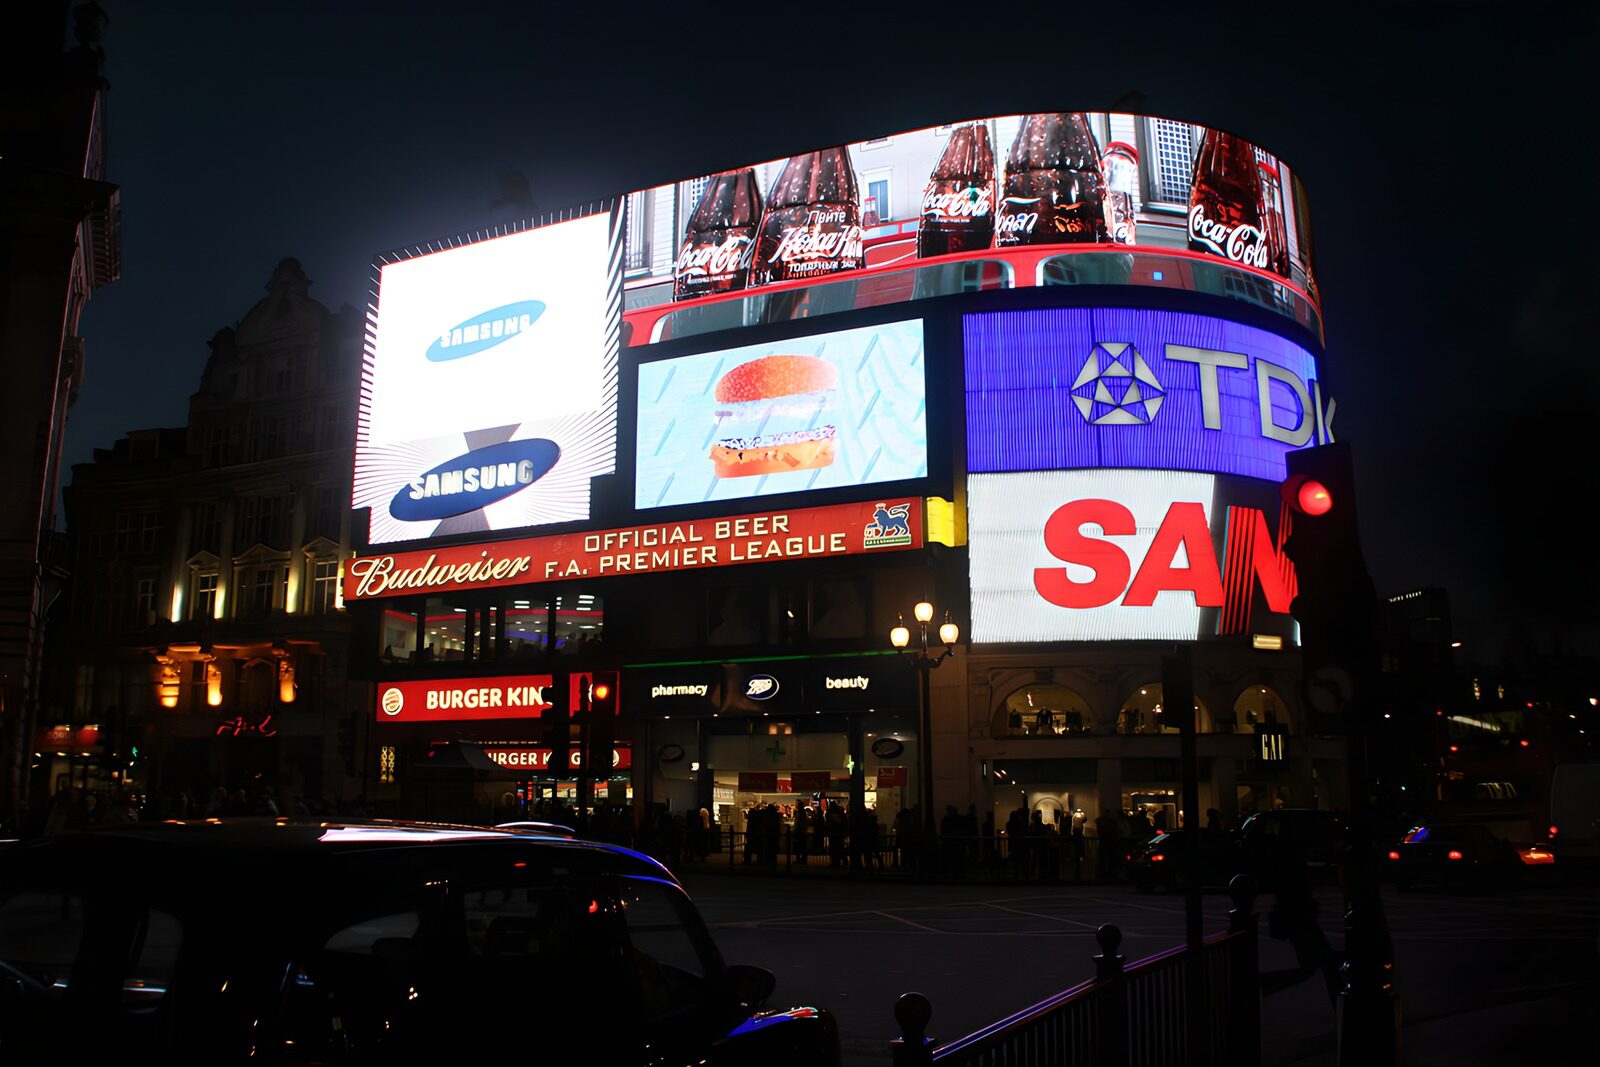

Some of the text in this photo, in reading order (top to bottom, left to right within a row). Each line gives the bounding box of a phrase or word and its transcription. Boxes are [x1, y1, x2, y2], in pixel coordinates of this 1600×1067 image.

[1188, 204, 1268, 268] Coca-Cola
[1164, 342, 1337, 447] TDK
[409, 459, 534, 500] SAMSUNG
[584, 515, 789, 552] OFFICIAL BEER
[351, 550, 531, 597] Budweiser
[545, 533, 846, 579] F.A. PREMIER LEAGUE
[426, 688, 503, 710] BURGER
[652, 684, 708, 698] pharmacy
[826, 675, 869, 690] beauty
[487, 752, 538, 765] URGER
